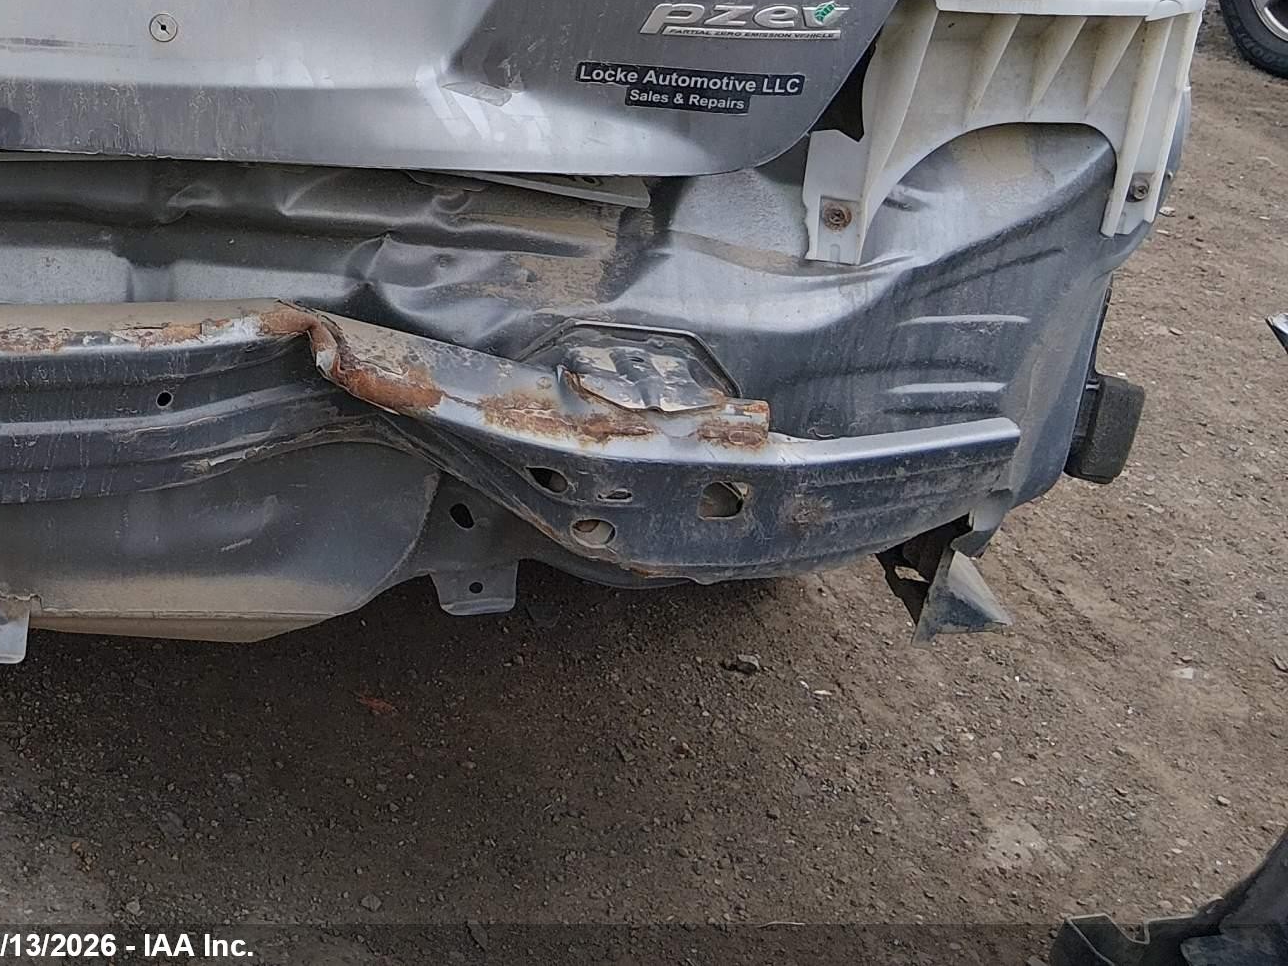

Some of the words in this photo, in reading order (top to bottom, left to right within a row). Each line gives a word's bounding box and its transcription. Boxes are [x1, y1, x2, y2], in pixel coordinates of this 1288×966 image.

[713, 29, 743, 37] ZERO
[744, 30, 791, 39] EMISSION
[579, 65, 638, 84] Locke
[643, 71, 757, 92] Automotive
[763, 77, 800, 93] LLC
[629, 89, 669, 103] Sales
[674, 92, 684, 104] &
[689, 94, 745, 111] Repairs
